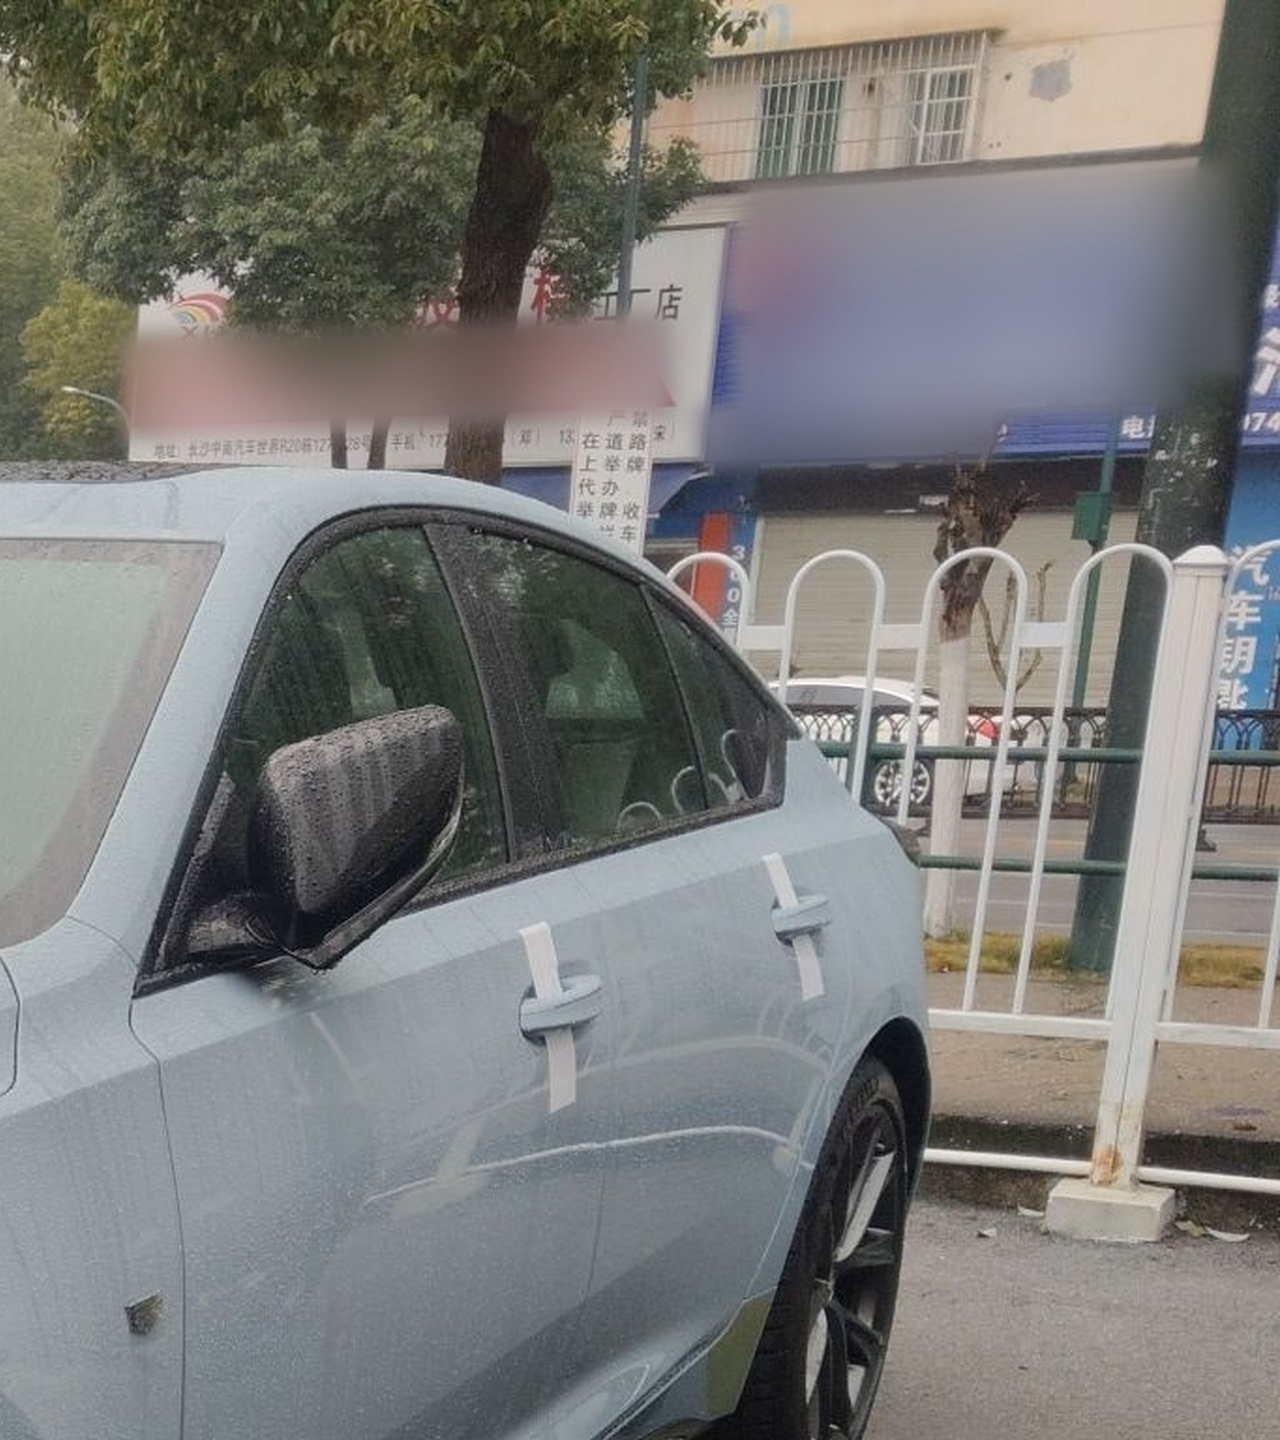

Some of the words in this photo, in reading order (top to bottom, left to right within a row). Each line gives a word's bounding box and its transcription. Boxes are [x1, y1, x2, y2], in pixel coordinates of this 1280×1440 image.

[582, 432, 647, 451] 在道路
[579, 455, 646, 473] 上举牌
[578, 478, 620, 497] 代办
